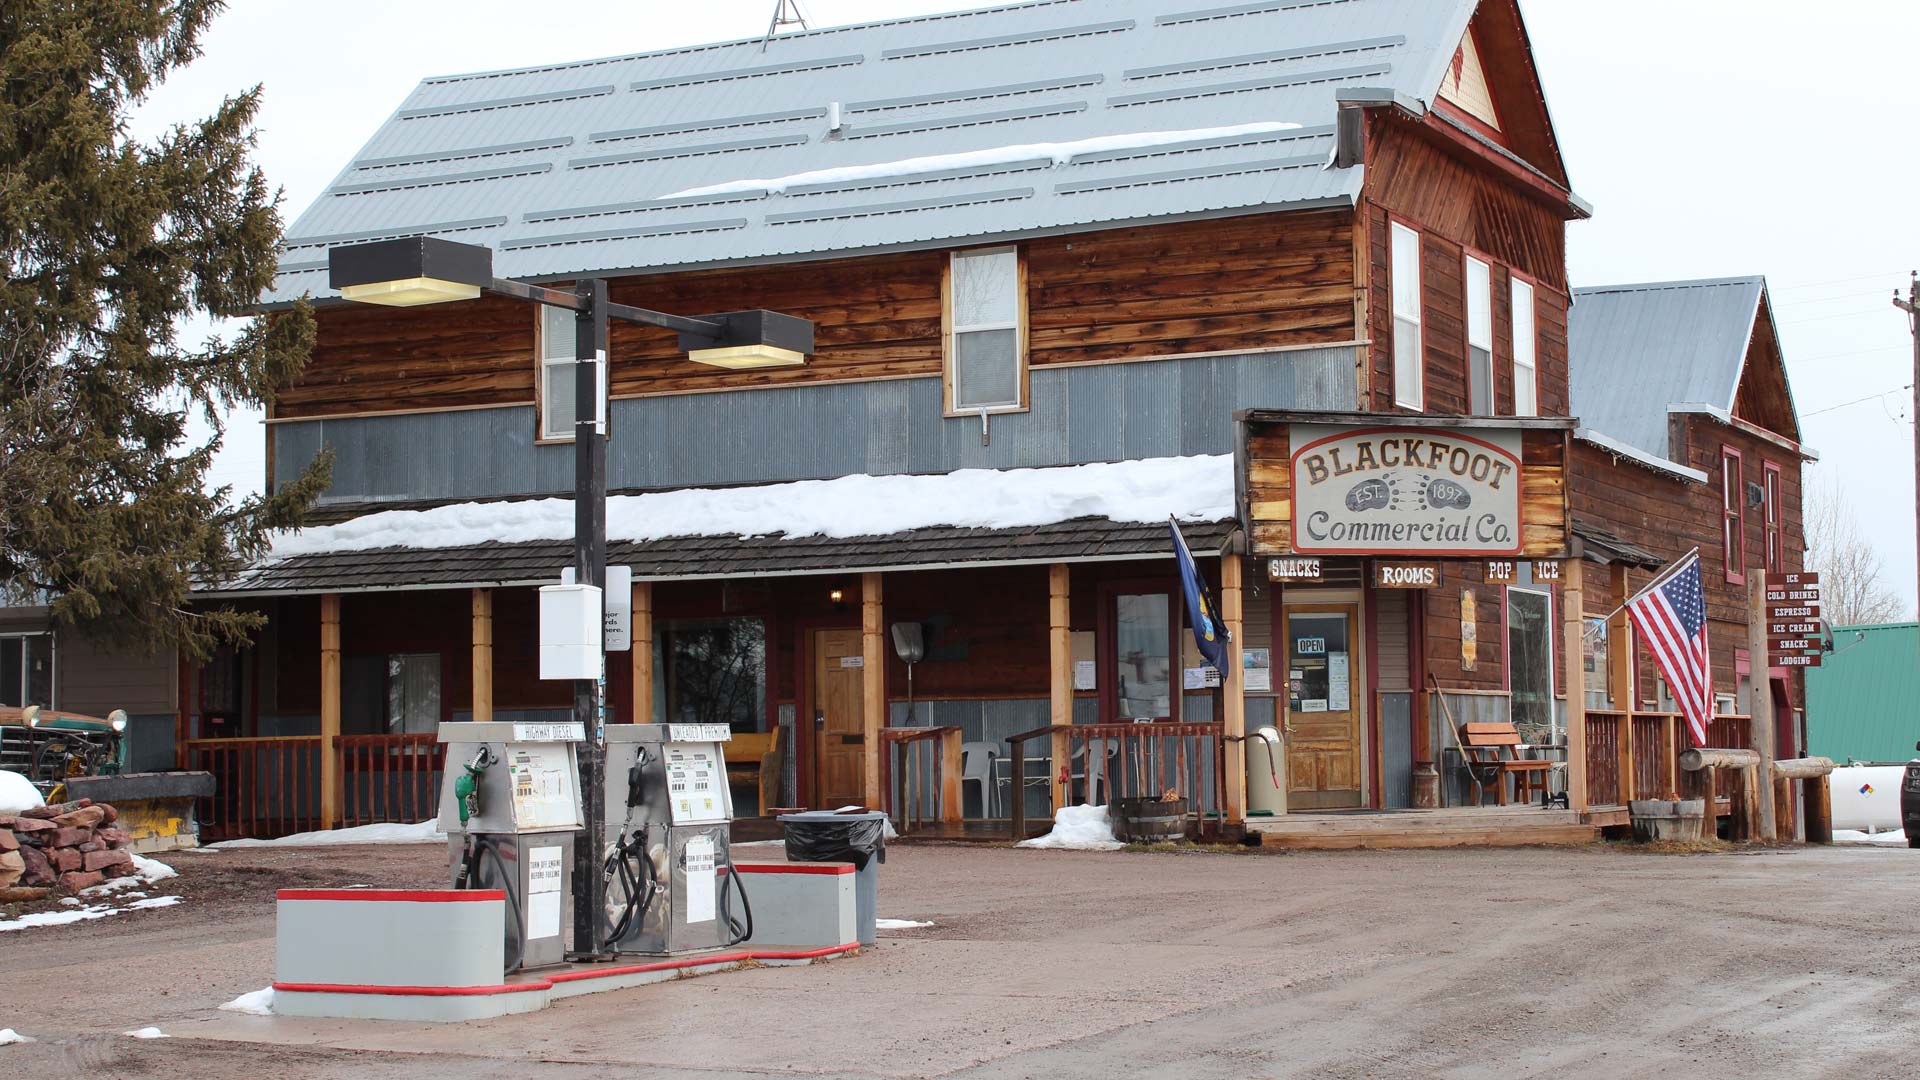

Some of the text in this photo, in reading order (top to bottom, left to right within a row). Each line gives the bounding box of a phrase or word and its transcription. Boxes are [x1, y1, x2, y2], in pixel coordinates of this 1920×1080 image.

[1303, 438, 1511, 490] BLACKFOOT
[1355, 484, 1463, 504] EST. 1897
[1306, 510, 1511, 543] Commercial Co.
[1271, 559, 1320, 578] SNACKS
[1382, 566, 1435, 585] ROOMS
[1489, 561, 1512, 580] POP
[1538, 561, 1559, 579] ICE
[1786, 574, 1799, 583] ICE
[1767, 591, 1818, 600] COLD DRINKS
[1774, 608, 1811, 617] ESPRESSO
[1773, 624, 1814, 633] ICE CREAM
[1299, 639, 1324, 652] OPEN
[1780, 640, 1808, 648] SNACKS
[1779, 656, 1811, 665] LODGING
[525, 725, 573, 739] HIGHWAY DIESEL
